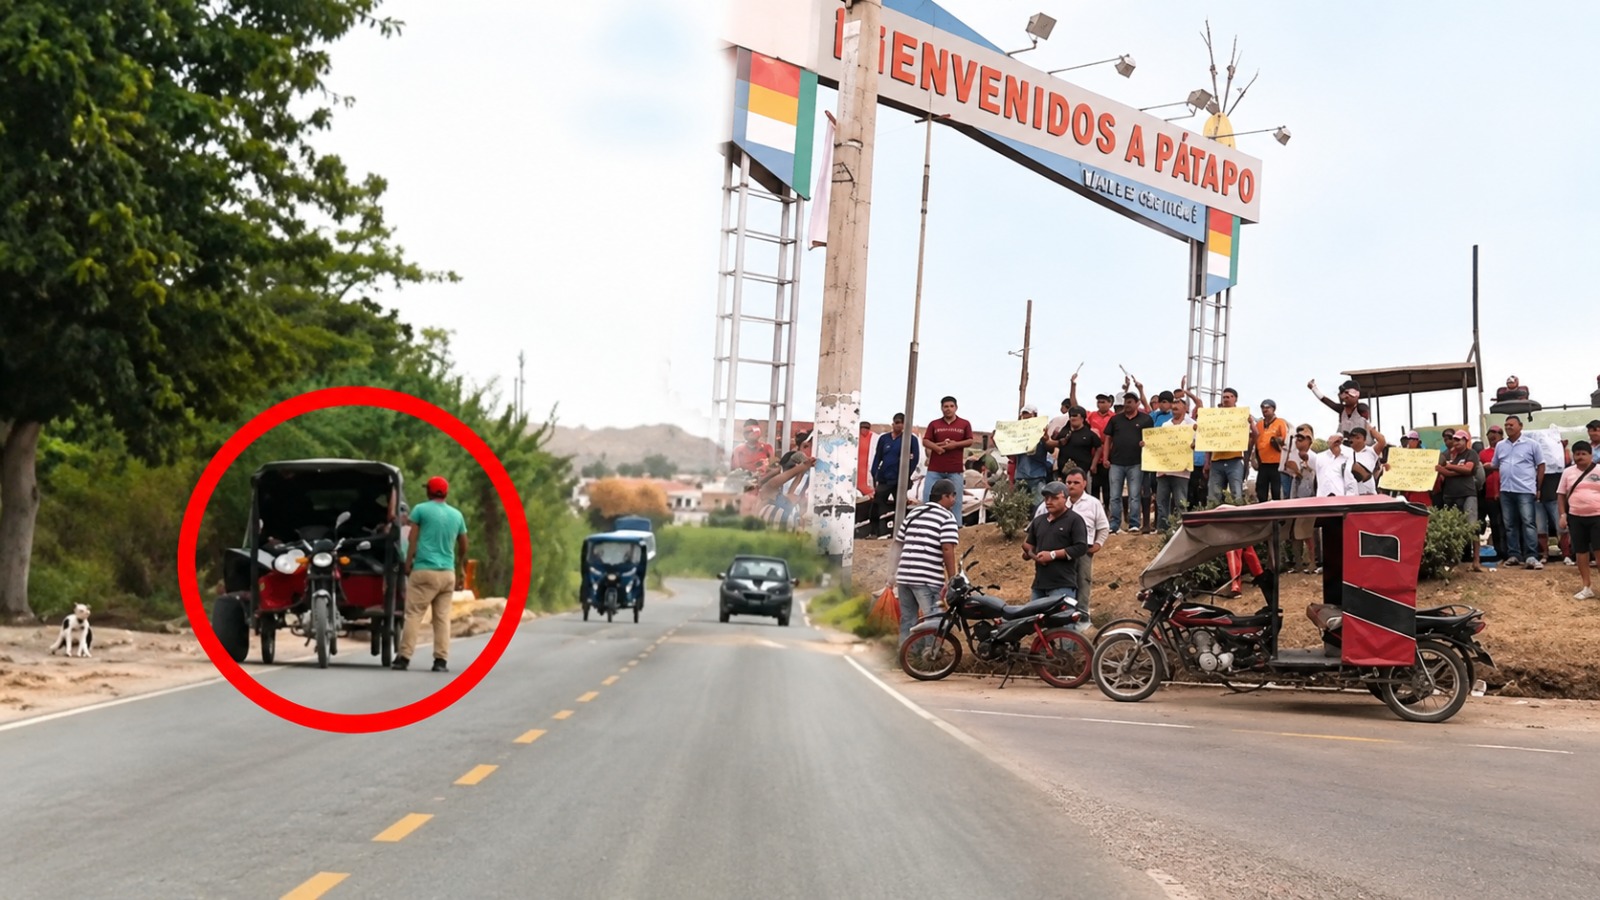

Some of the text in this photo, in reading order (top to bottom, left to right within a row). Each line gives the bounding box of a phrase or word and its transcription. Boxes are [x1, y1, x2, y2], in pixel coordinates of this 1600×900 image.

[834, 7, 1255, 204] IENVENIDOS A PÁTAPO
